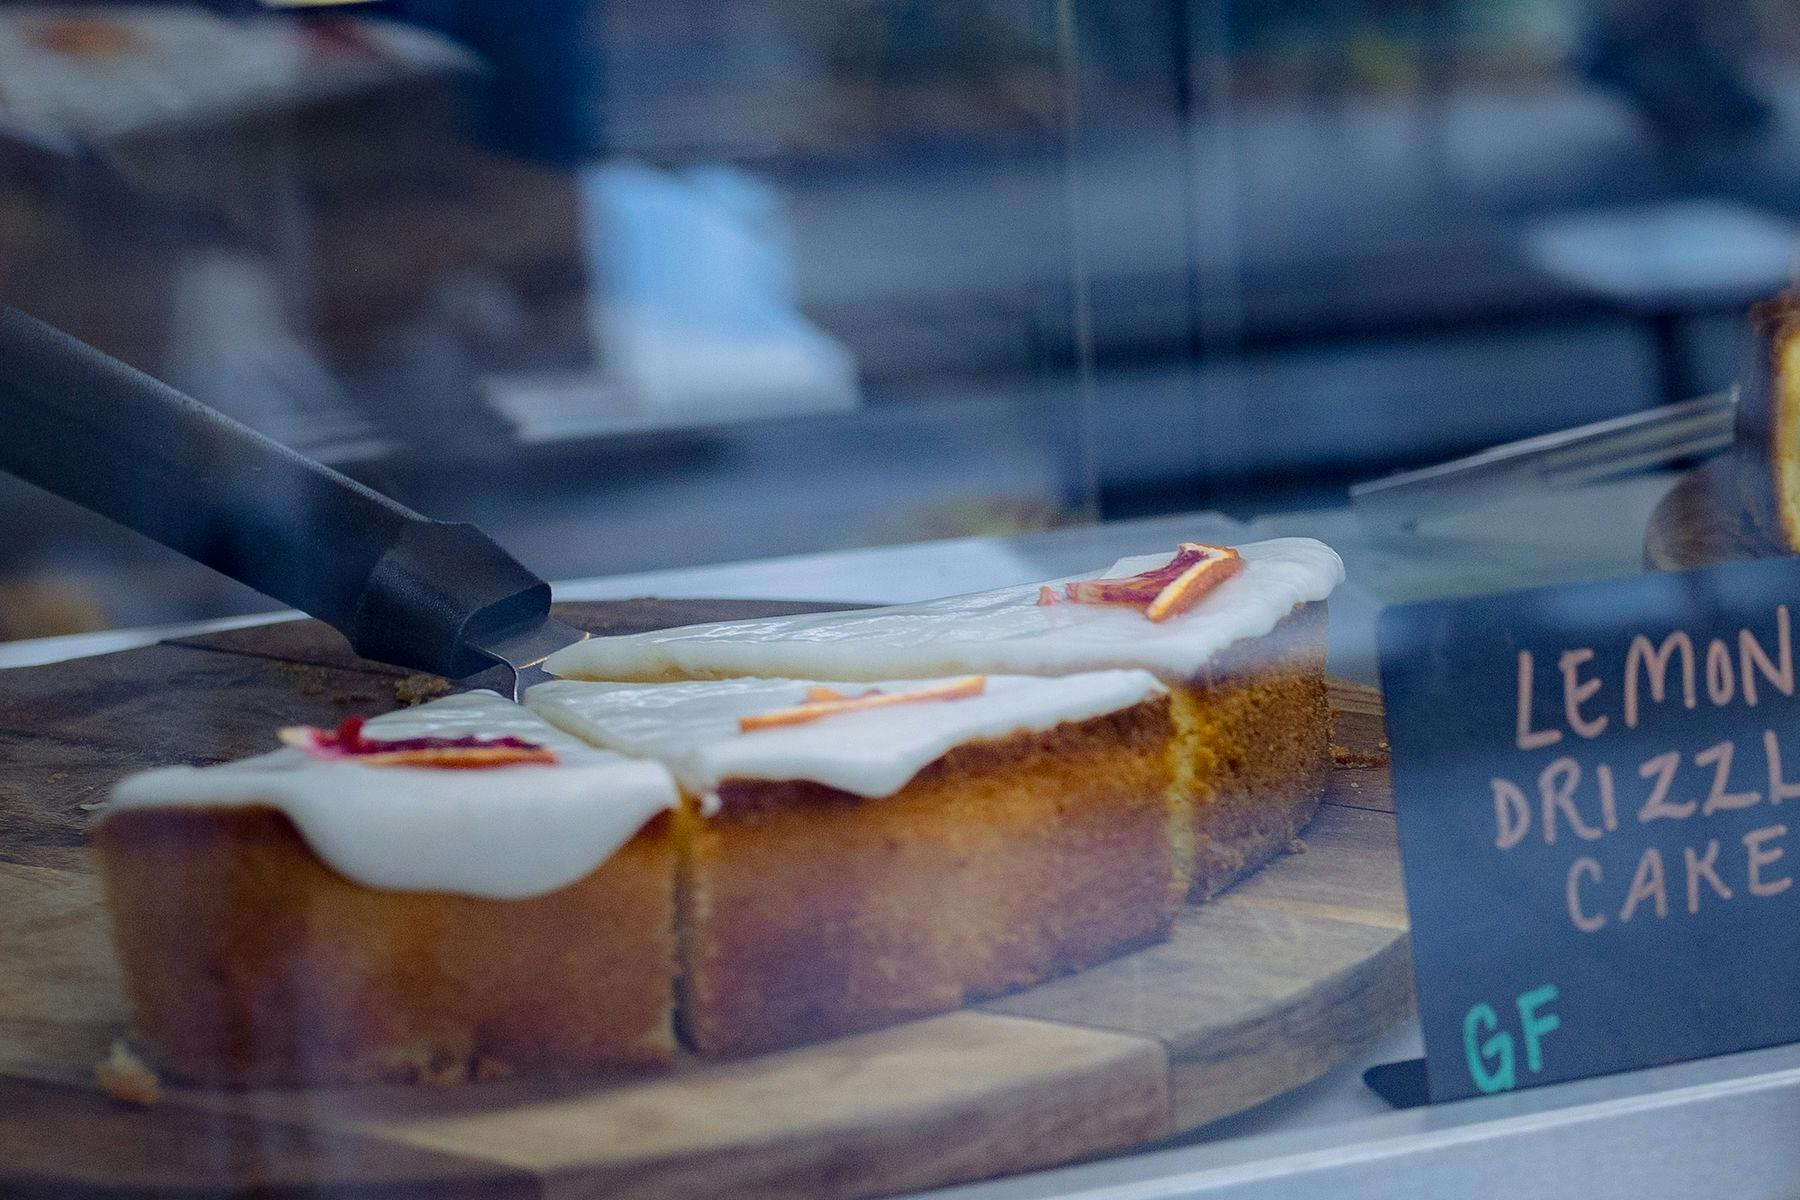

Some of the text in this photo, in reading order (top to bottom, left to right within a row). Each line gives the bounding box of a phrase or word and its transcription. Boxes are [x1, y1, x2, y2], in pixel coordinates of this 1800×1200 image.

[1516, 605, 1794, 749] LEMON
[1566, 825, 1793, 932] CAKE
[1462, 984, 1560, 1094] GF
